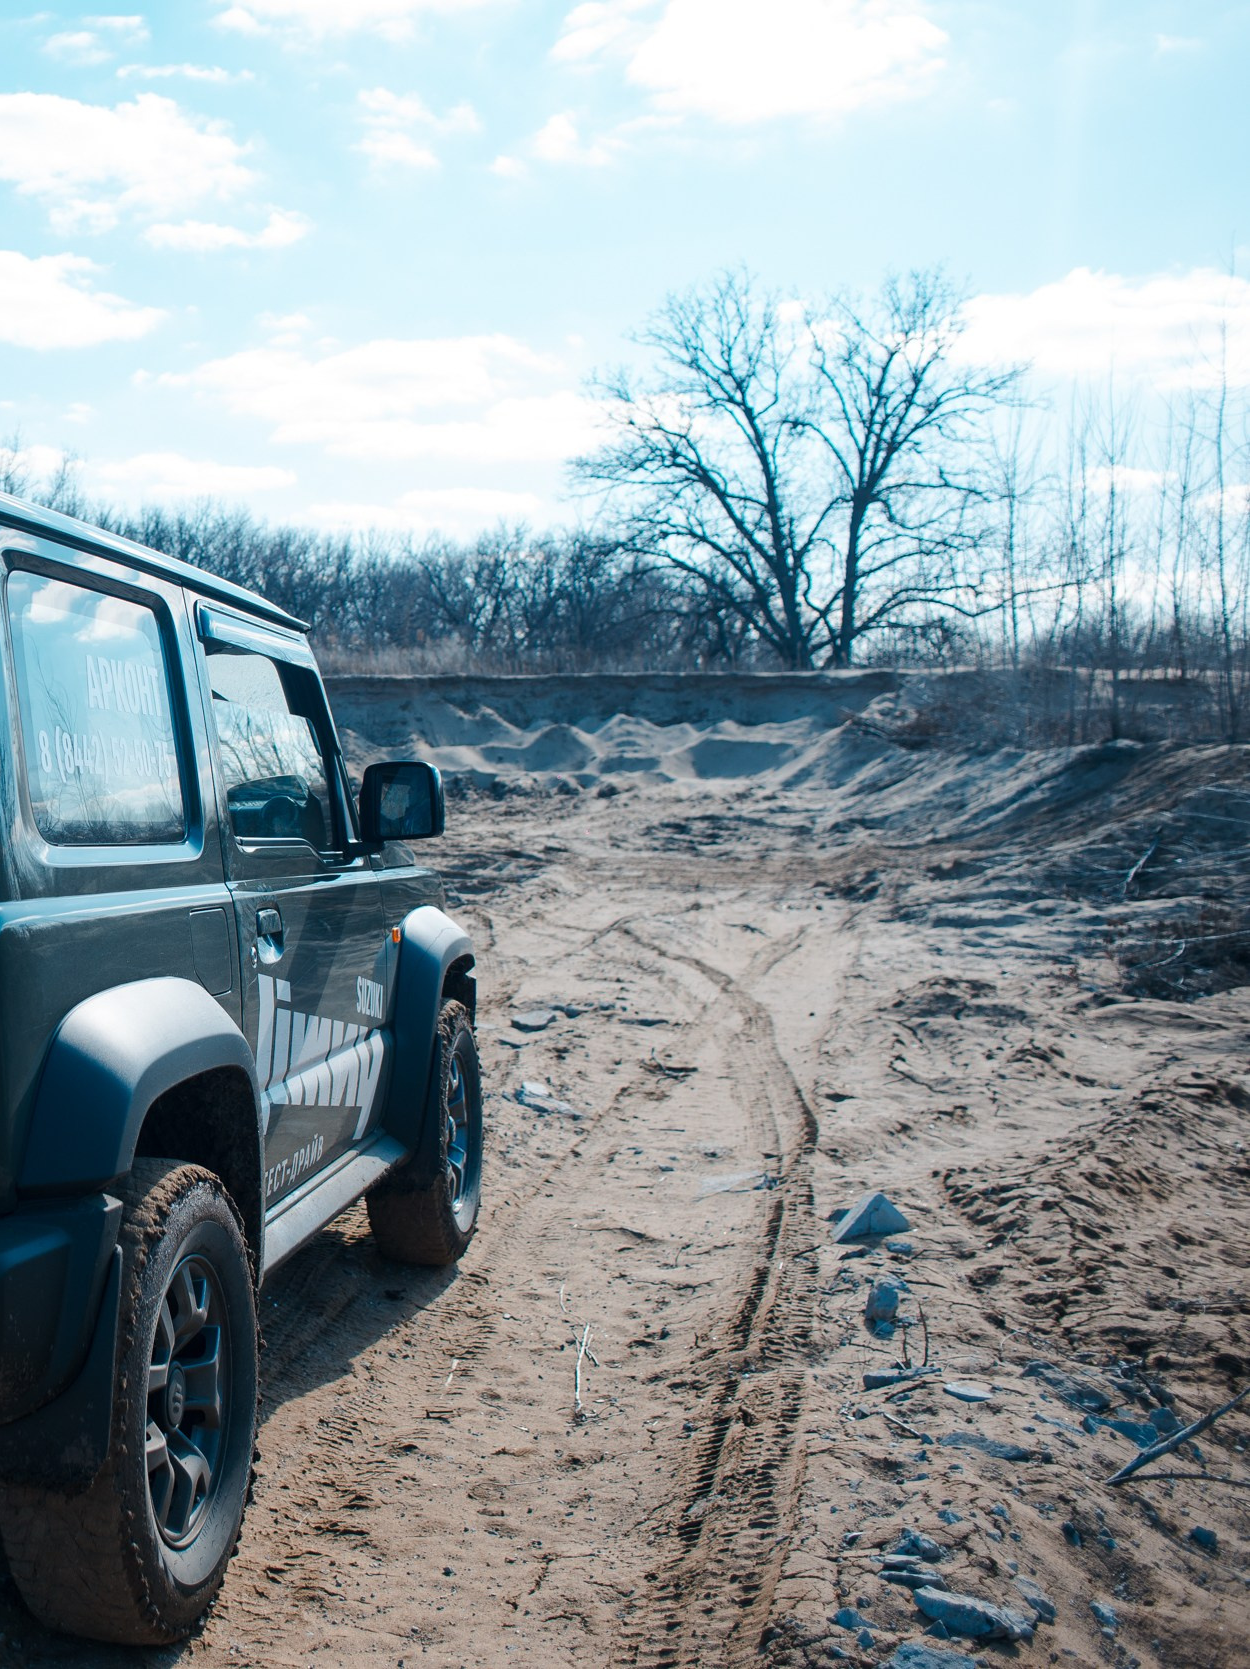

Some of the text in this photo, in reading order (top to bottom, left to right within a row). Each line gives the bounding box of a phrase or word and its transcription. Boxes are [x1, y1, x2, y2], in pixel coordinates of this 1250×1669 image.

[86, 654, 162, 716] АРКОНТ
[39, 730, 52, 773] 8
[55, 725, 109, 784] (8442)
[356, 976, 384, 1019] SUZUKI
